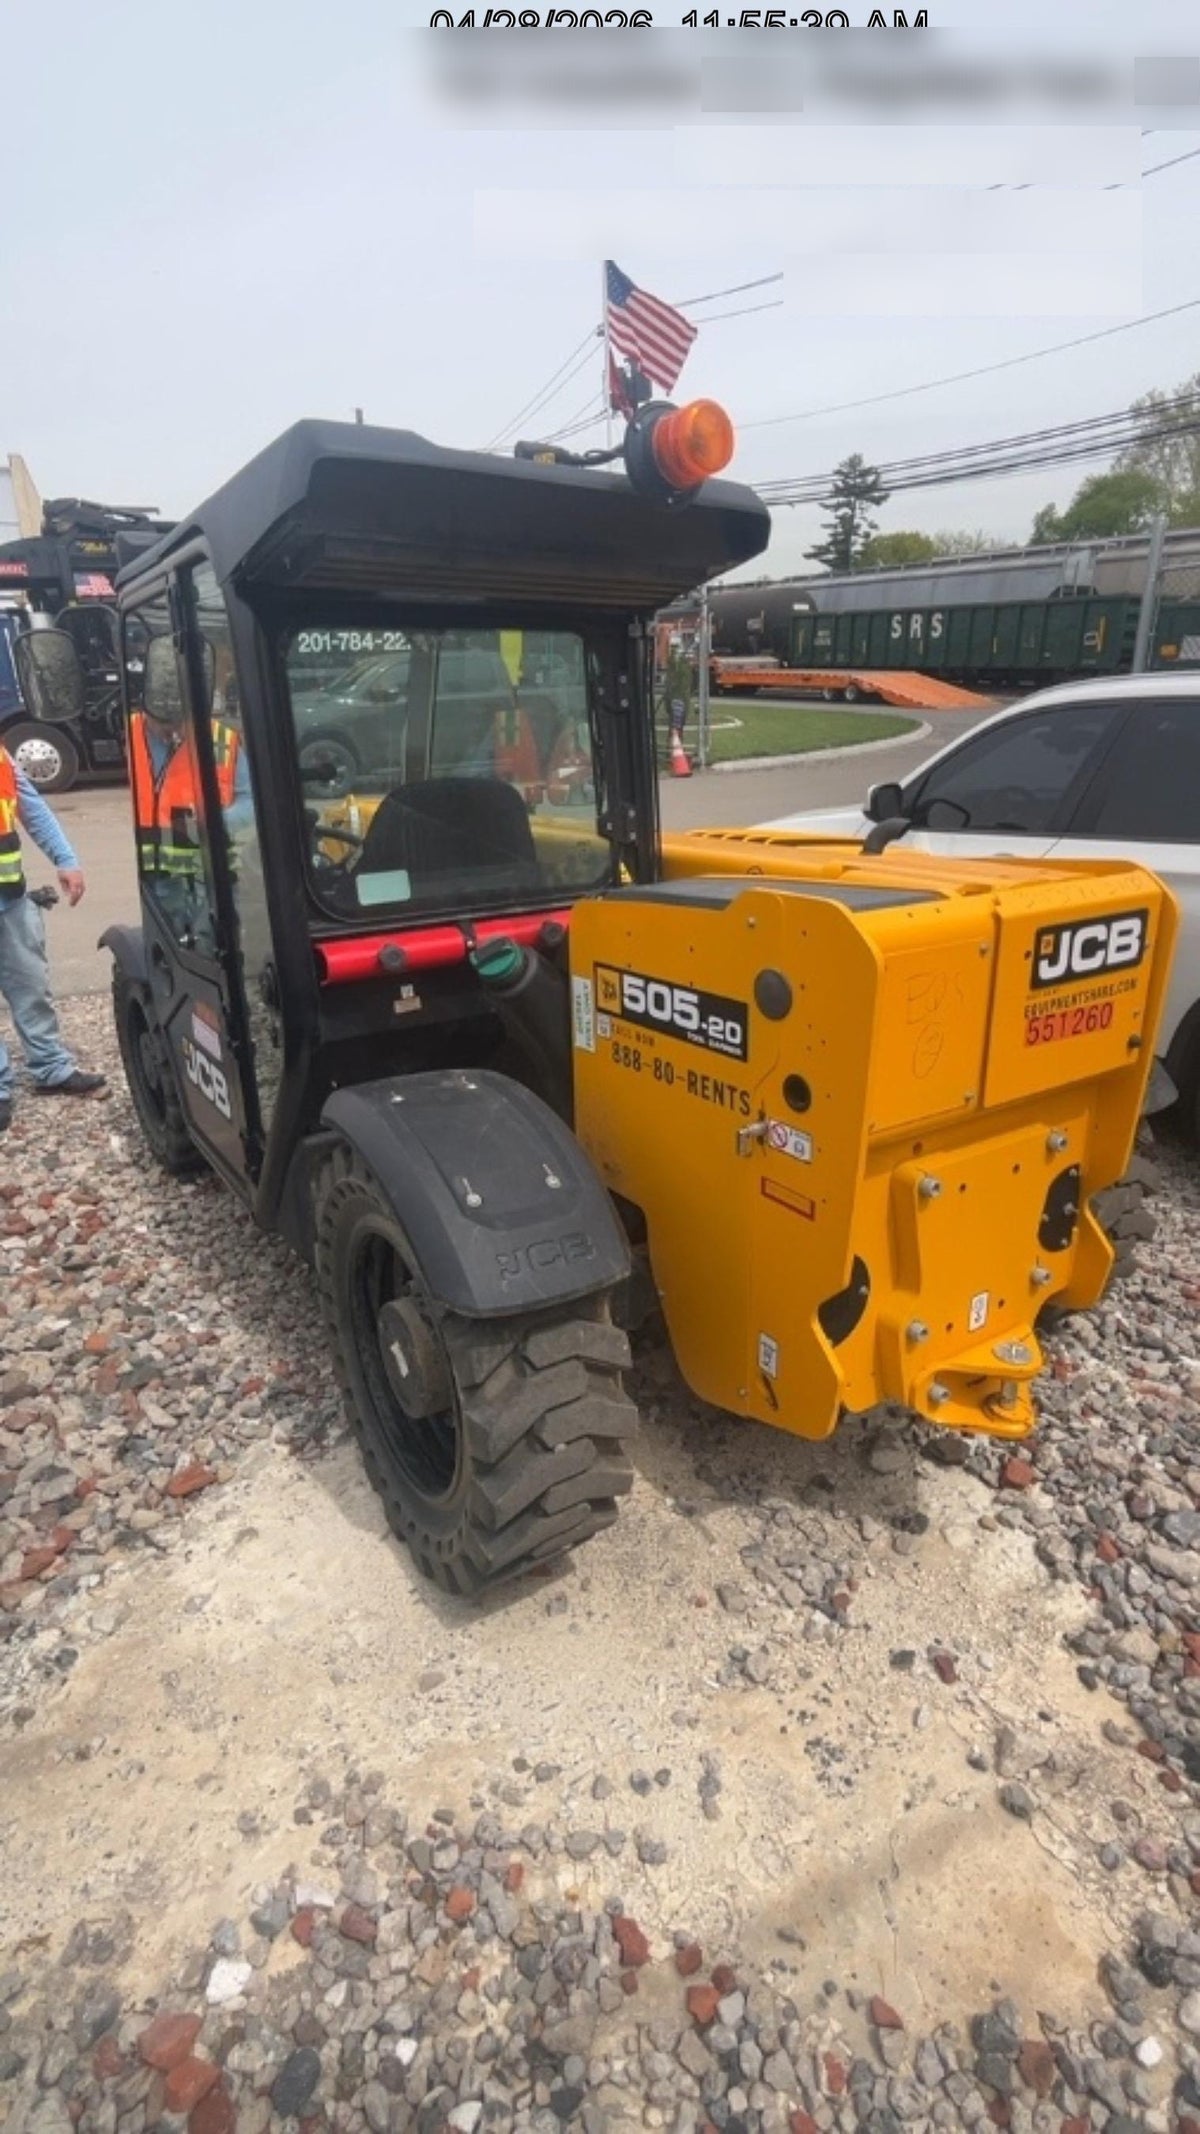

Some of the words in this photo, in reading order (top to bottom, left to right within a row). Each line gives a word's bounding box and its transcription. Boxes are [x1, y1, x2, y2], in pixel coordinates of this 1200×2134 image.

[298, 631, 411, 653] 201-784-22
[890, 612, 944, 639] SRS
[1038, 917, 1142, 980] JCB
[1026, 1002, 1114, 1046] 551260
[185, 1047, 232, 1119] JCB
[612, 1041, 751, 1117] 888-80-RENTS
[496, 1232, 595, 1281] JCB
